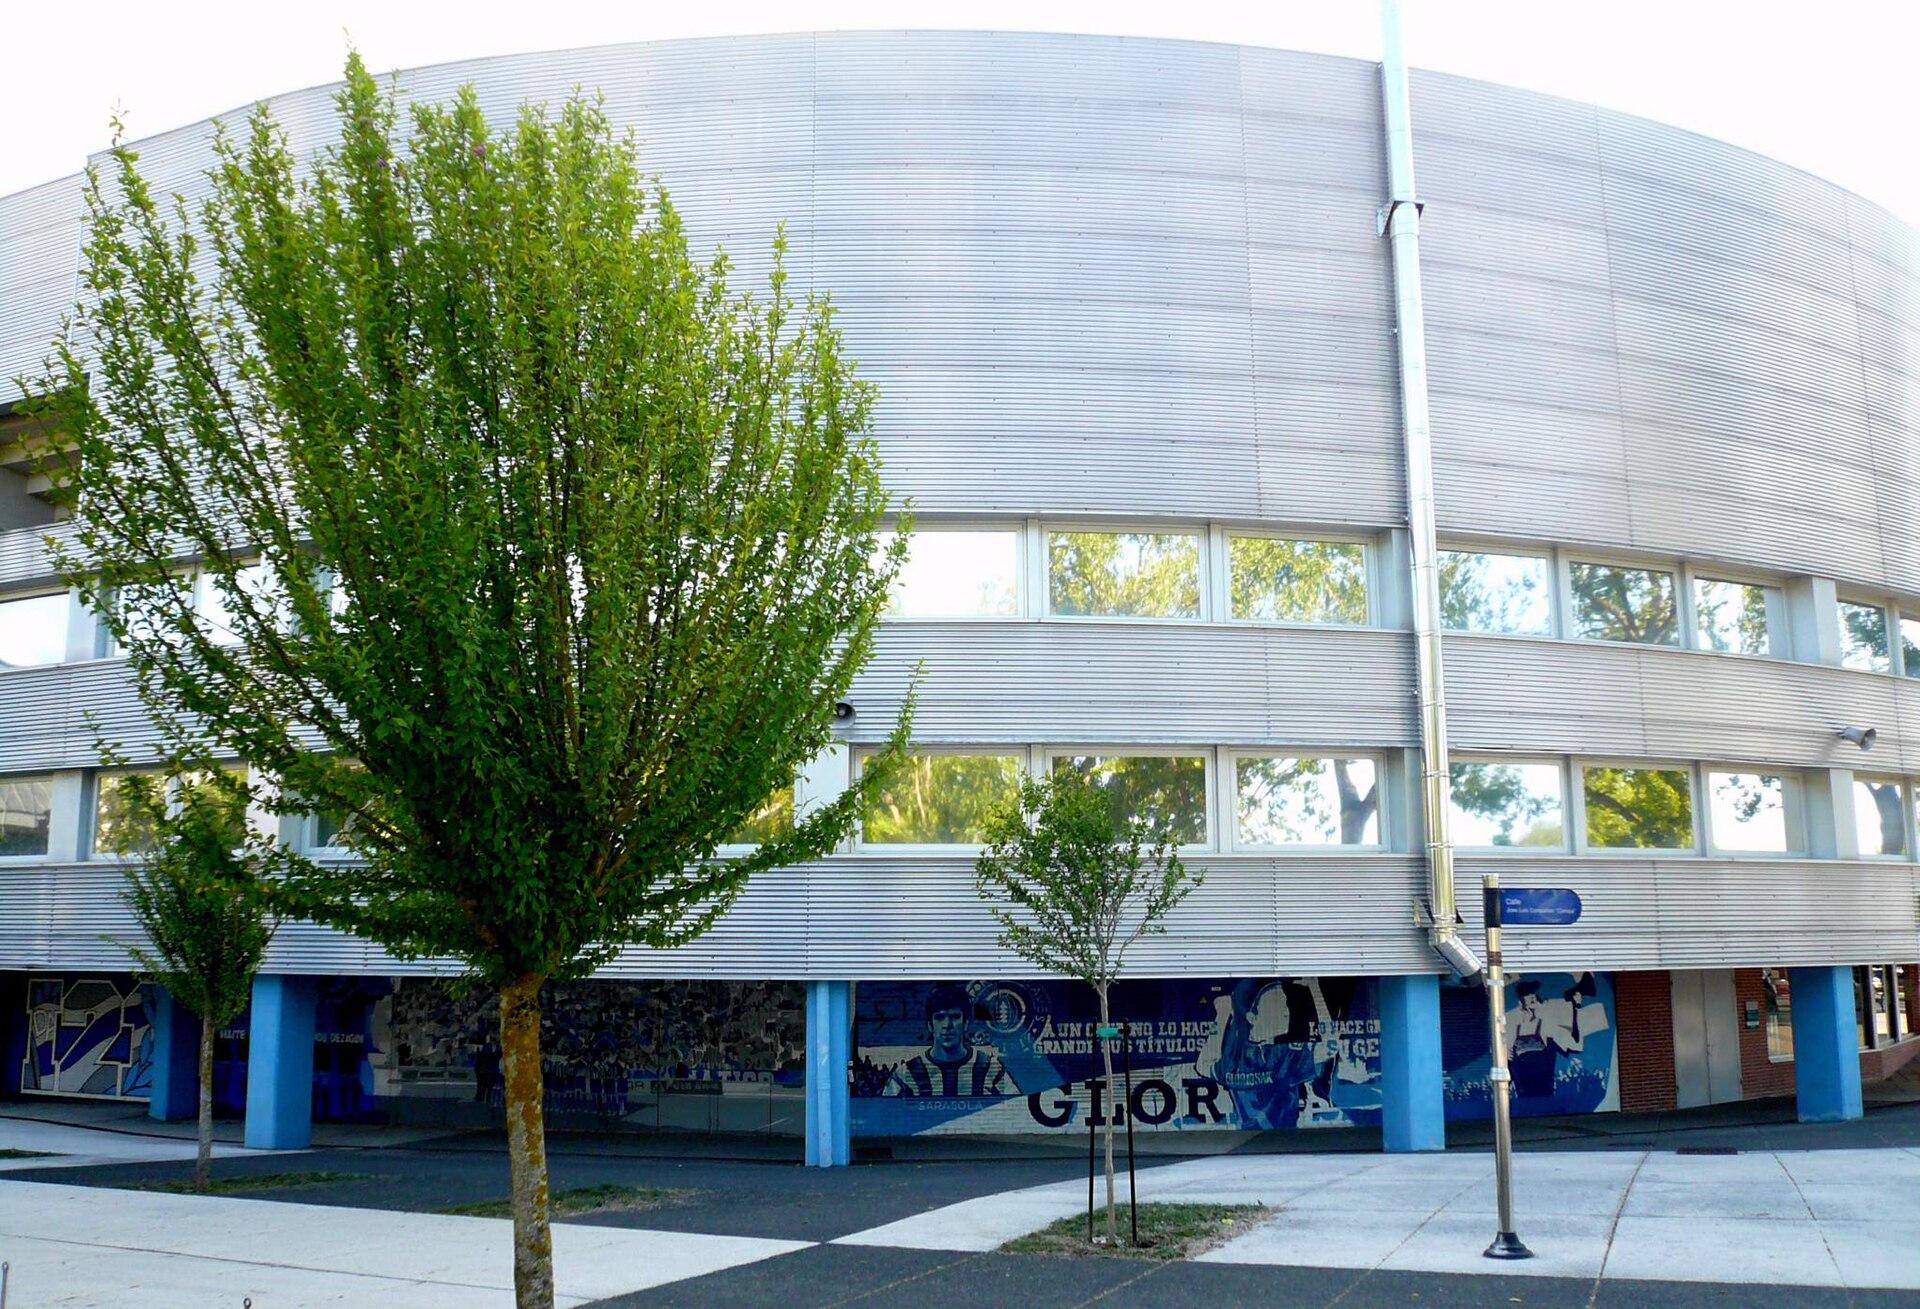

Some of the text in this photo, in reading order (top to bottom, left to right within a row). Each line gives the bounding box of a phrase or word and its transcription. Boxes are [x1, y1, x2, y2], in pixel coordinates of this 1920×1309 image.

[1057, 1022, 1082, 1038] UN
[1127, 1021, 1154, 1038] NO
[1158, 1021, 1177, 1036] LO
[1181, 1020, 1218, 1037] HACE
[1136, 1035, 1206, 1054] TÍTULOS
[918, 1100, 984, 1112] SARASOLA
